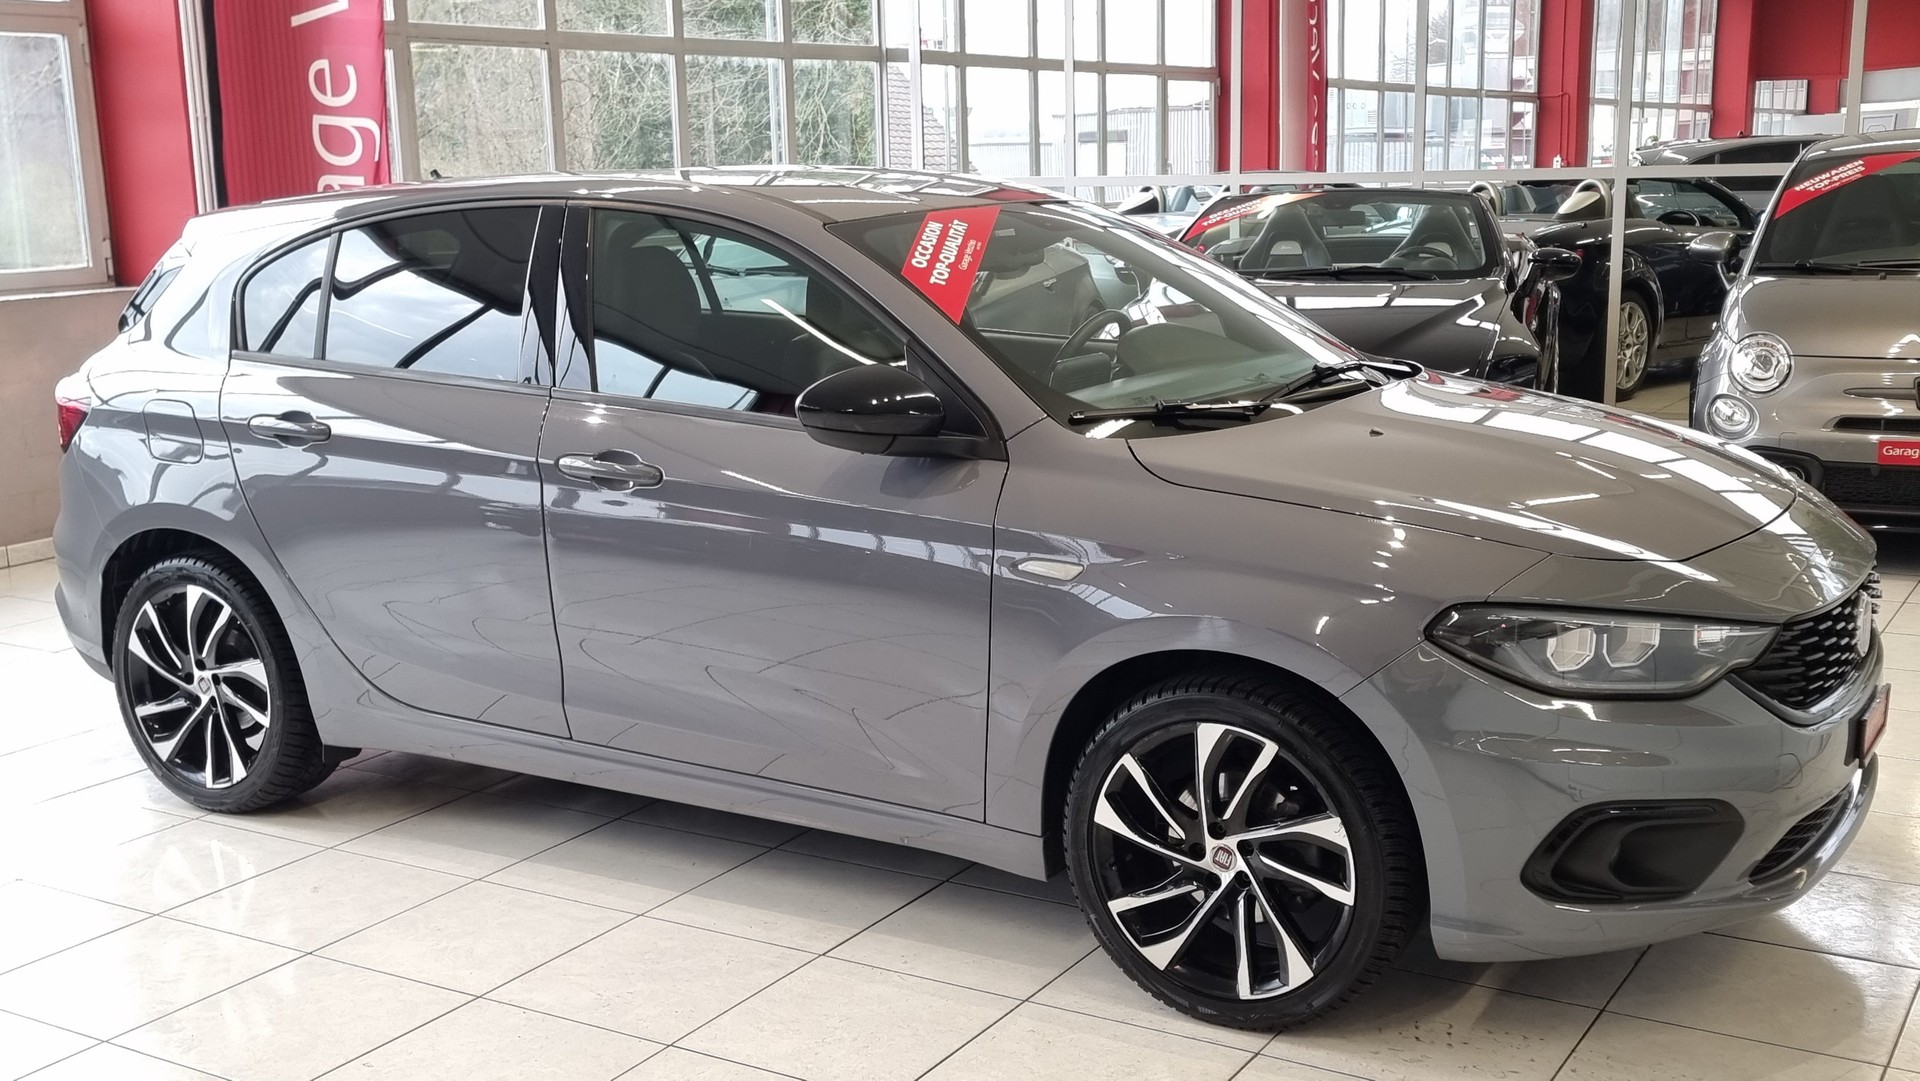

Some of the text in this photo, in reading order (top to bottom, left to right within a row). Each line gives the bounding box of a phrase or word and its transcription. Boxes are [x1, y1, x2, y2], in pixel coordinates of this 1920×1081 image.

[1794, 160, 1864, 191] NEUWAGEN
[1806, 166, 1865, 191] TOP-PREIS
[1208, 199, 1262, 219] OCCASION
[911, 221, 943, 268] OCCASION
[929, 219, 968, 285] TOP-QUALITÄT
[1883, 445, 1920, 458] Garag
